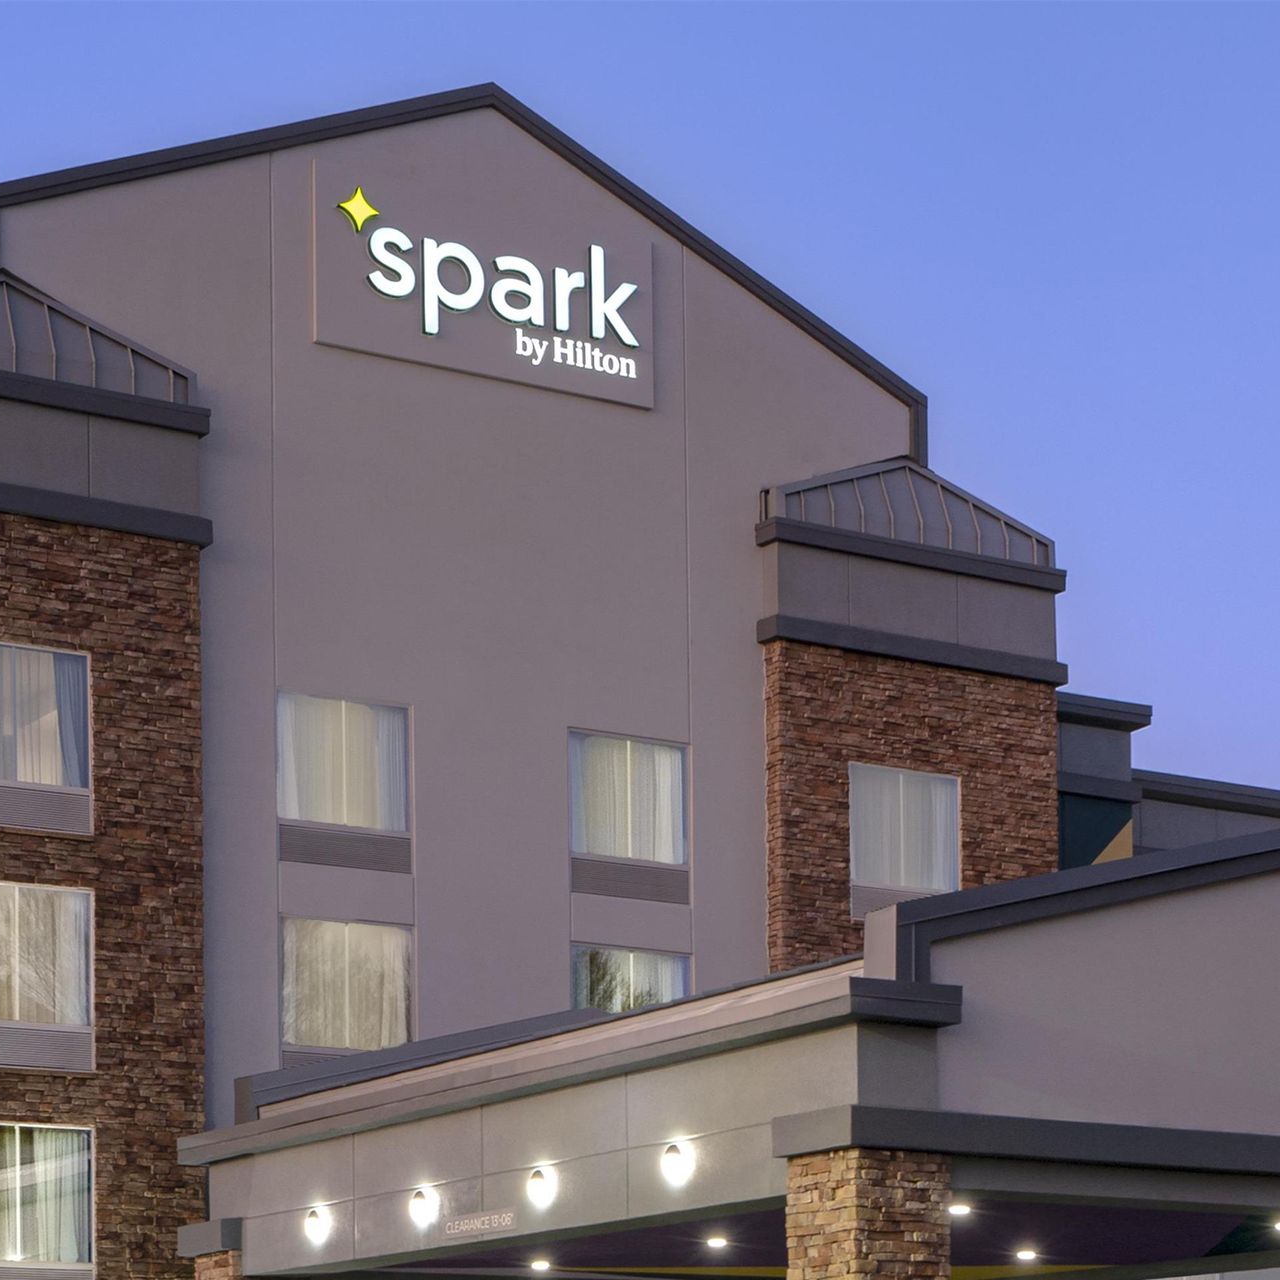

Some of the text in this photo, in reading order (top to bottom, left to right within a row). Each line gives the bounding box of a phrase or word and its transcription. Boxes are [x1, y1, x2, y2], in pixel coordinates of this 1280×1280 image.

[367, 226, 640, 348] spark
[515, 328, 638, 379] by Hilton
[446, 1216, 489, 1233] CLEARANCE
